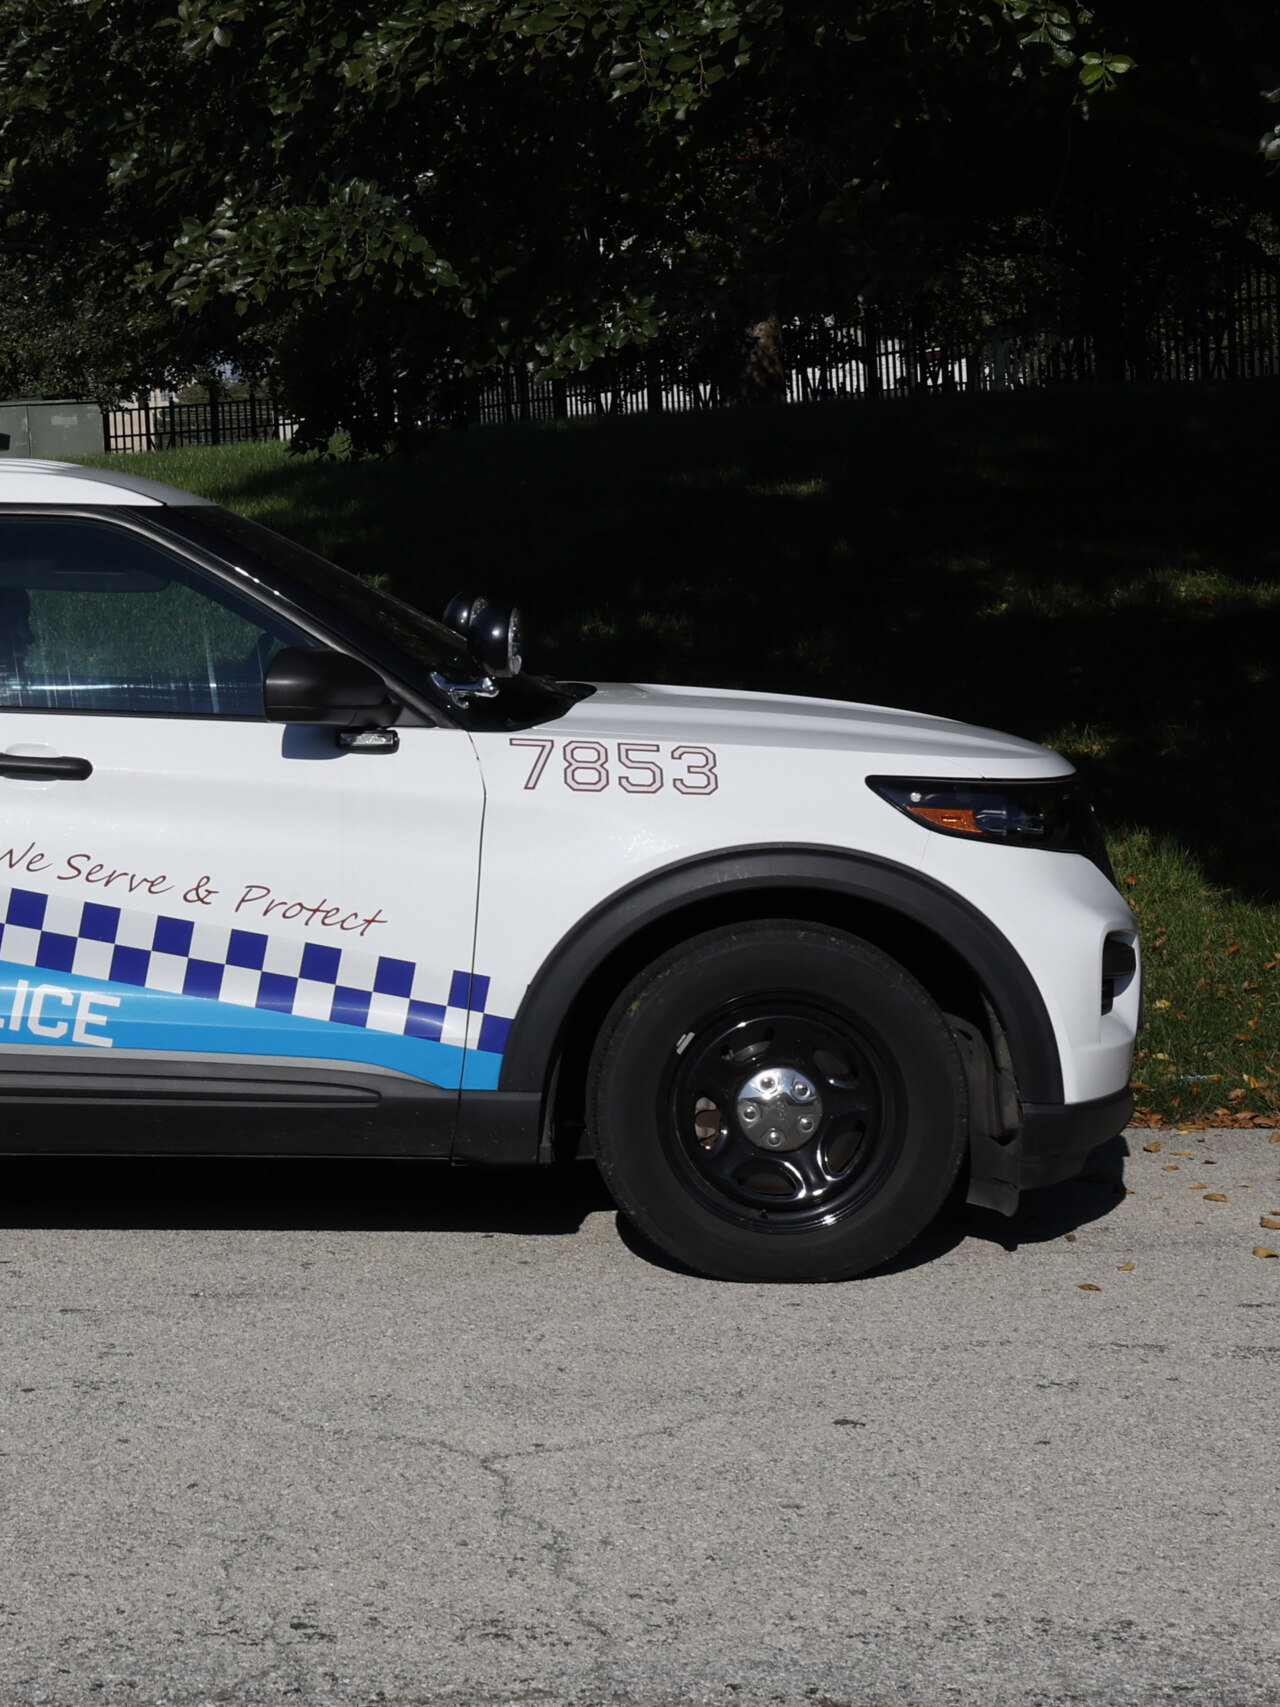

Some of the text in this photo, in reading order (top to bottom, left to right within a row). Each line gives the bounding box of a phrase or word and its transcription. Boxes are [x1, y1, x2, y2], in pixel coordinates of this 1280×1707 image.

[509, 738, 718, 795] 7853
[56, 853, 175, 895] Serve
[182, 875, 219, 905] &
[234, 885, 387, 936] Protect
